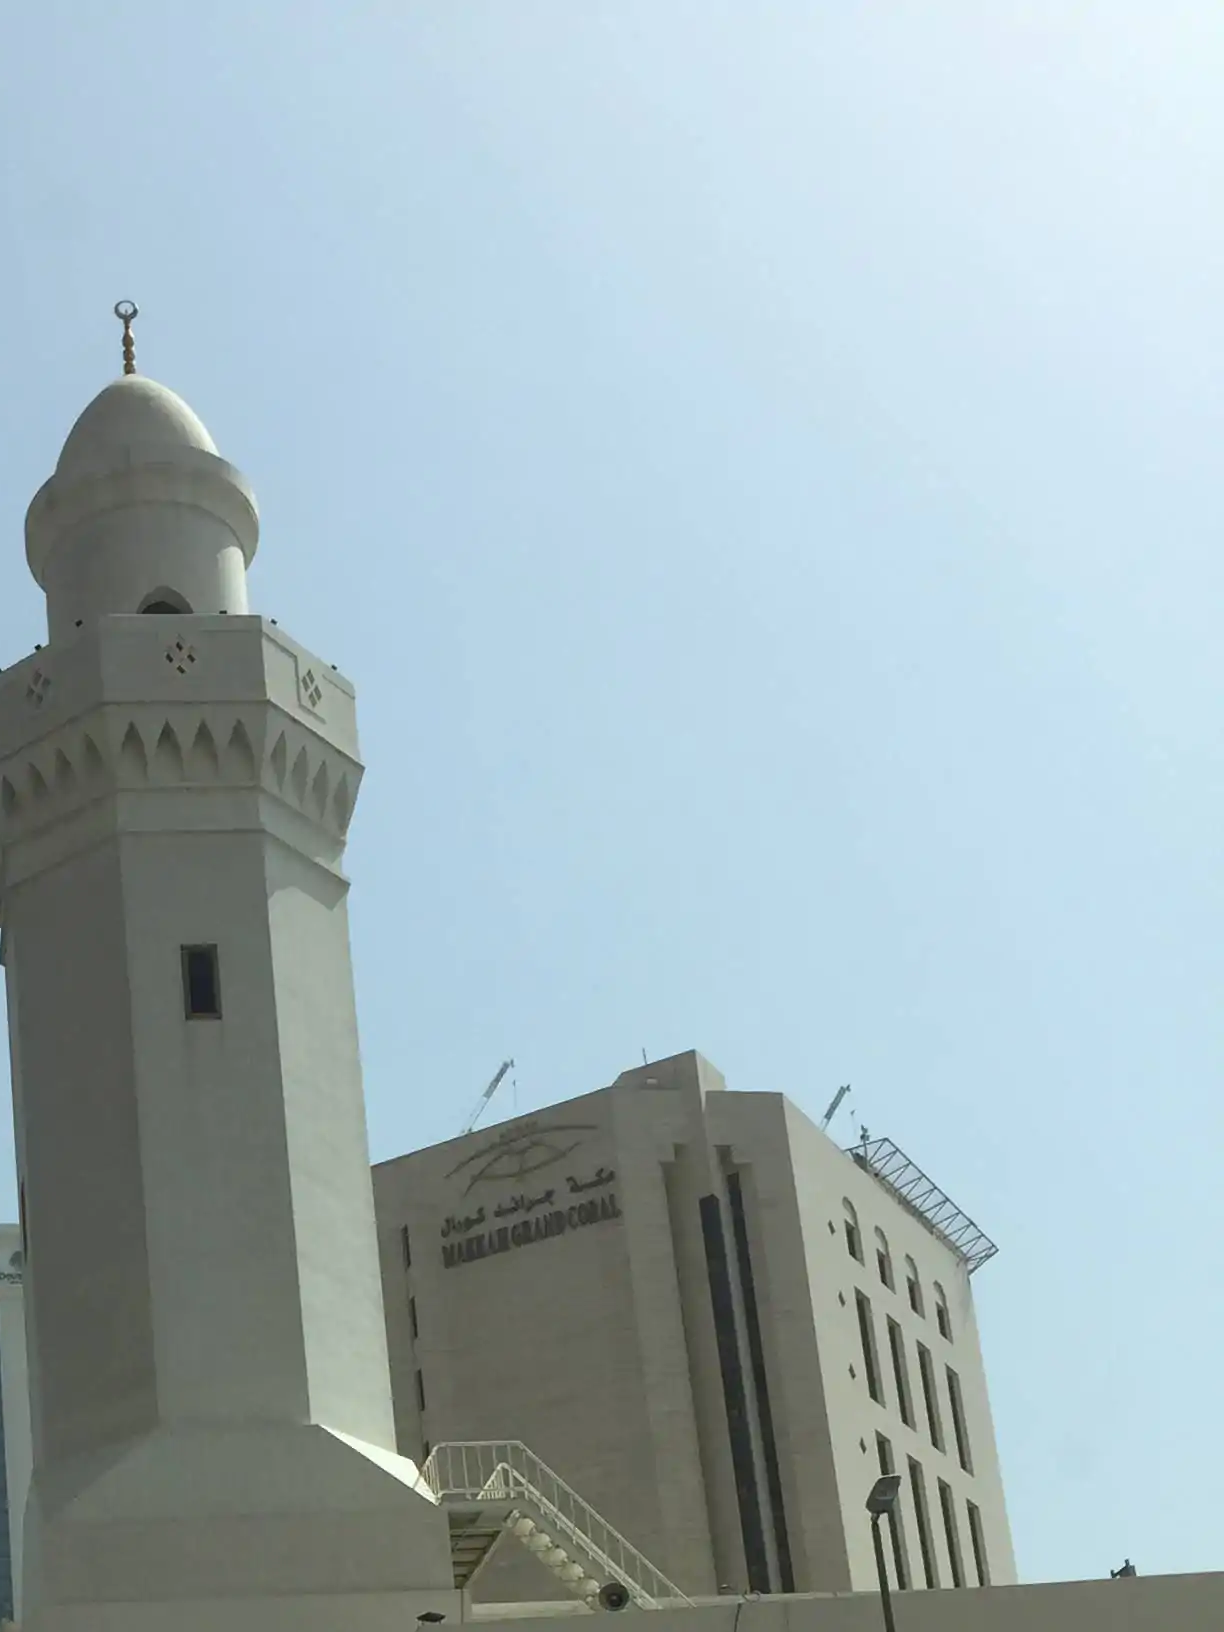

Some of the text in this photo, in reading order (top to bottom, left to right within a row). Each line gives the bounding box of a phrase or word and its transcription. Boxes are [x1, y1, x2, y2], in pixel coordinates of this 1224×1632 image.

[441, 1193, 623, 1269] MAKKAH GRAND CORAL
